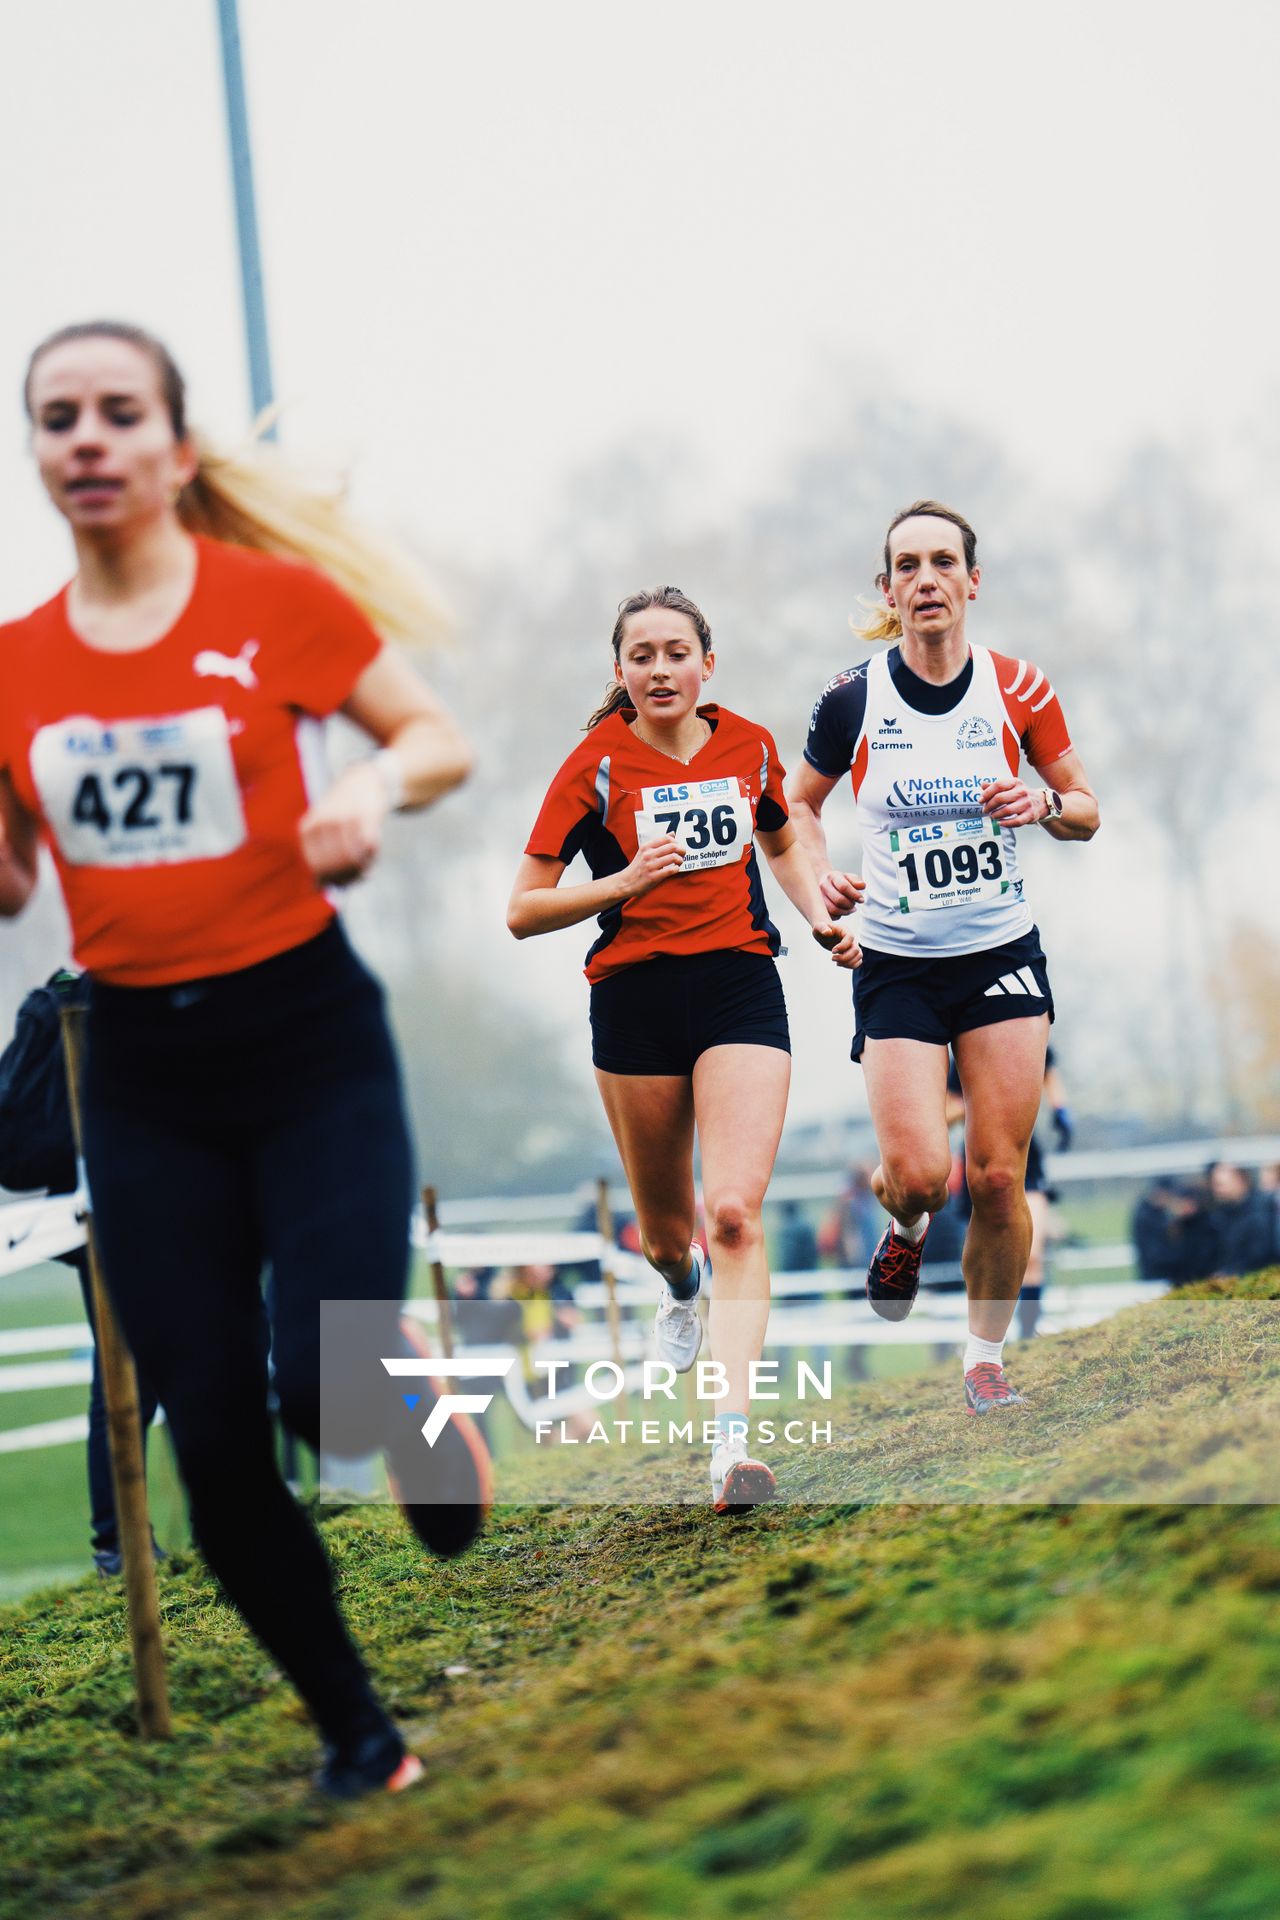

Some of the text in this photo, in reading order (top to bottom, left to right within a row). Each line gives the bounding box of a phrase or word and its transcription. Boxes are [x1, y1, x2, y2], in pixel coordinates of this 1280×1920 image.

[871, 741, 913, 750] Carmen
[72, 764, 195, 834] 427
[916, 790, 960, 806] Klink
[888, 806, 983, 819] BEZIRKSDIREKT
[654, 804, 738, 850] 736
[699, 849, 728, 861] Schöpfer
[898, 841, 1003, 892] 1093
[929, 886, 981, 900] Carmen Keppler
